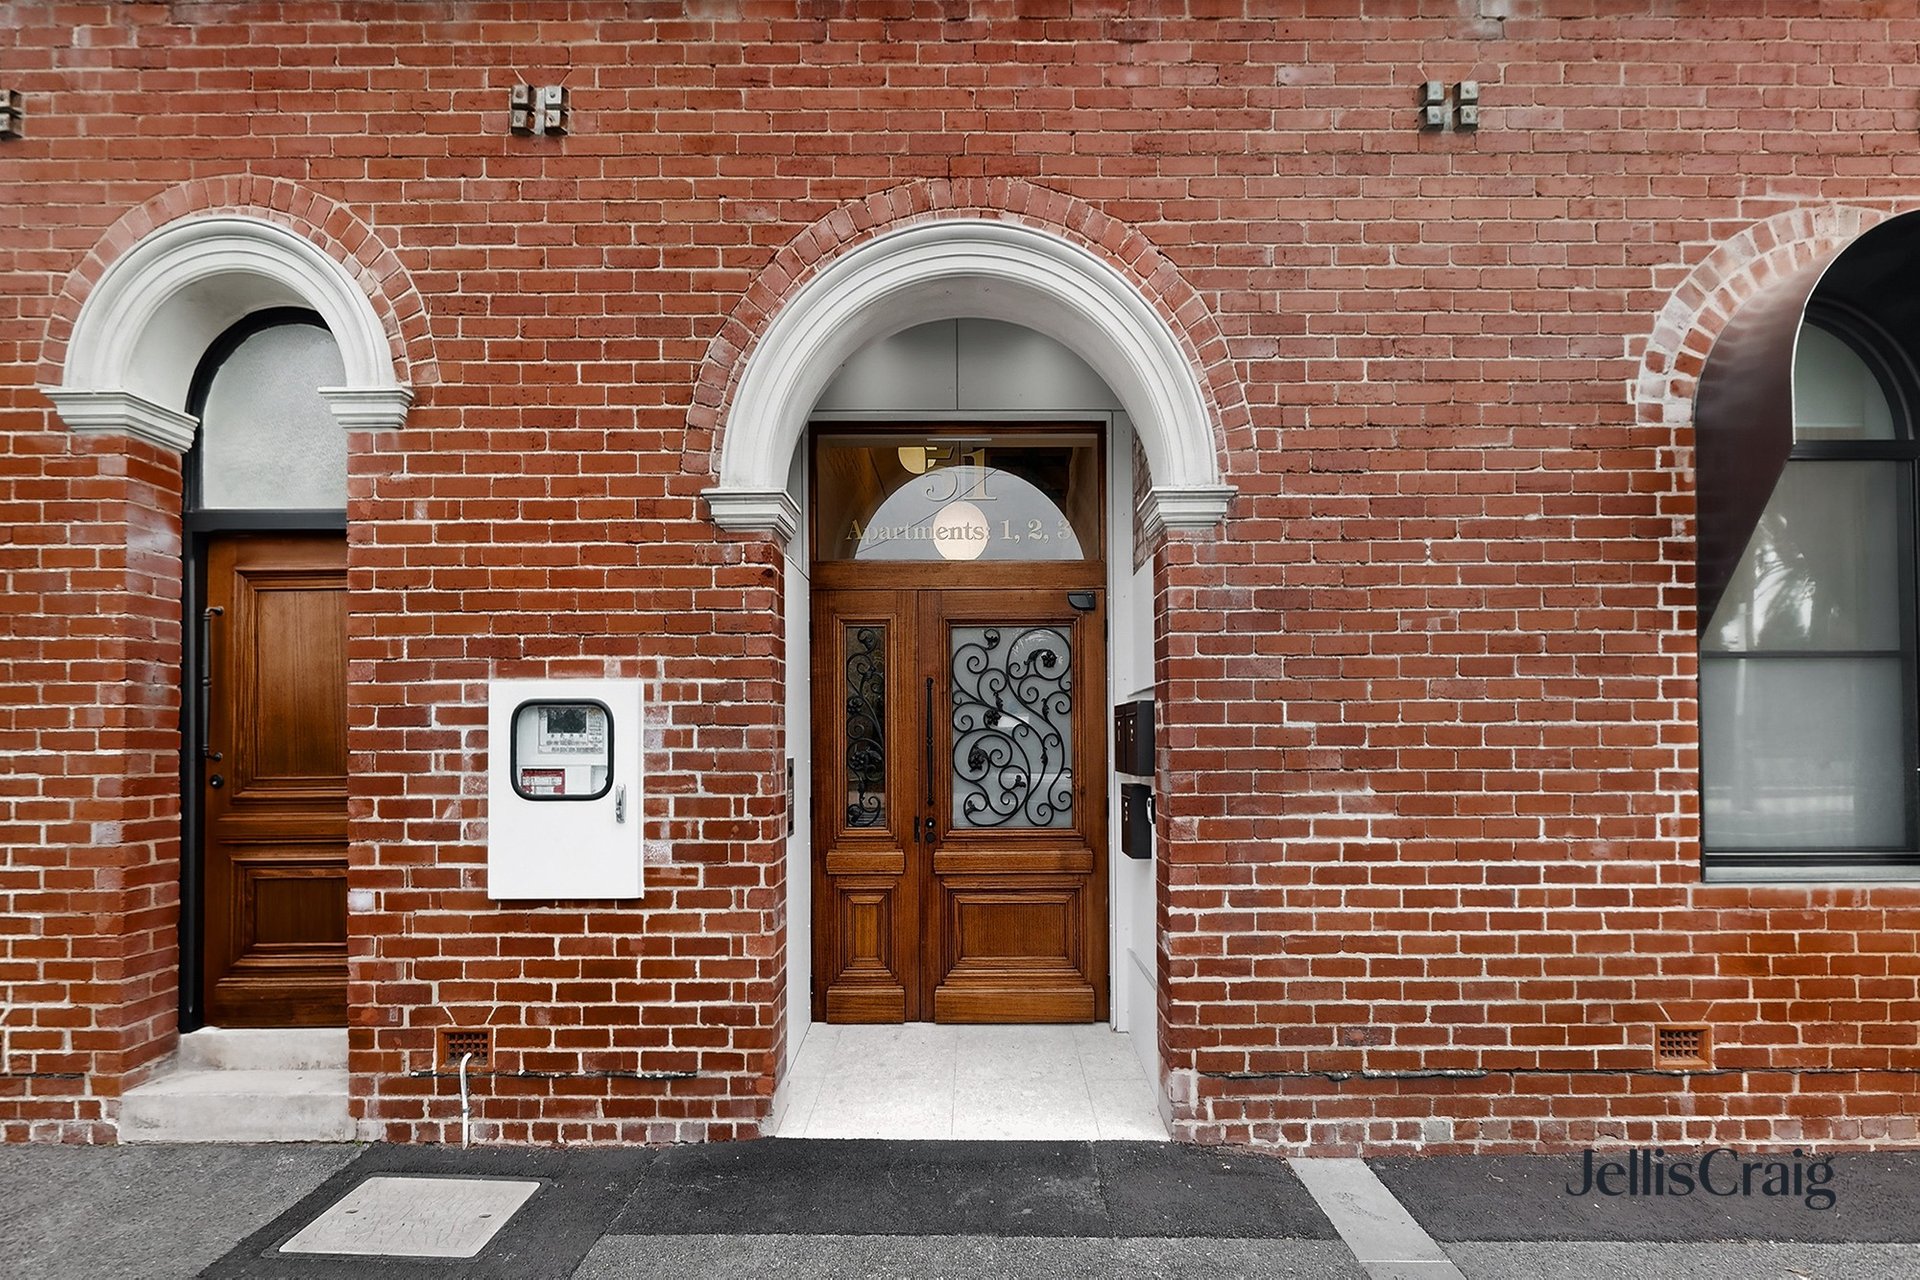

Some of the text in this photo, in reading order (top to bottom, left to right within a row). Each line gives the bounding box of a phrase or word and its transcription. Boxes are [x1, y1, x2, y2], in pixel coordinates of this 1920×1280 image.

[924, 445, 998, 502] 51
[999, 519, 1021, 544] 1,
[1027, 518, 1049, 544] 2,
[1057, 519, 1073, 540] 3
